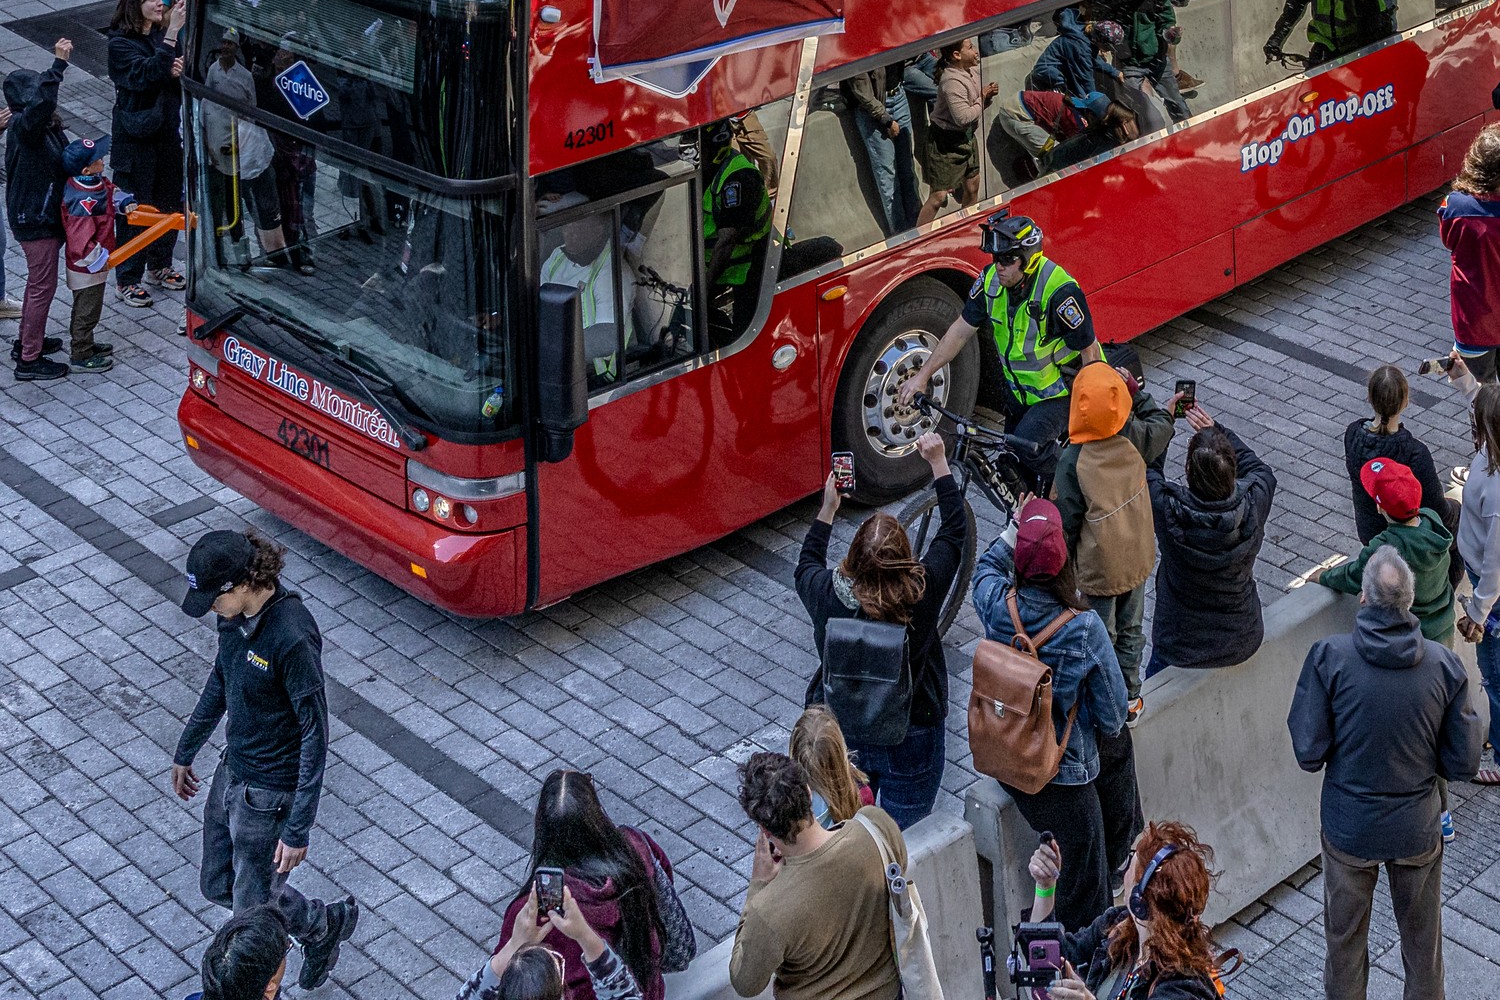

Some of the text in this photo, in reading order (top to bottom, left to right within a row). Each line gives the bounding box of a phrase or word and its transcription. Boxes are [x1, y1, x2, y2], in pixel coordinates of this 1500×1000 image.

[564, 119, 614, 150] 42301
[1240, 84, 1395, 173] Hop-On Hop-Off
[1058, 298, 1074, 314] POLICE
[223, 336, 268, 380] Gray
[267, 356, 309, 400] Line
[276, 416, 331, 469] 42301
